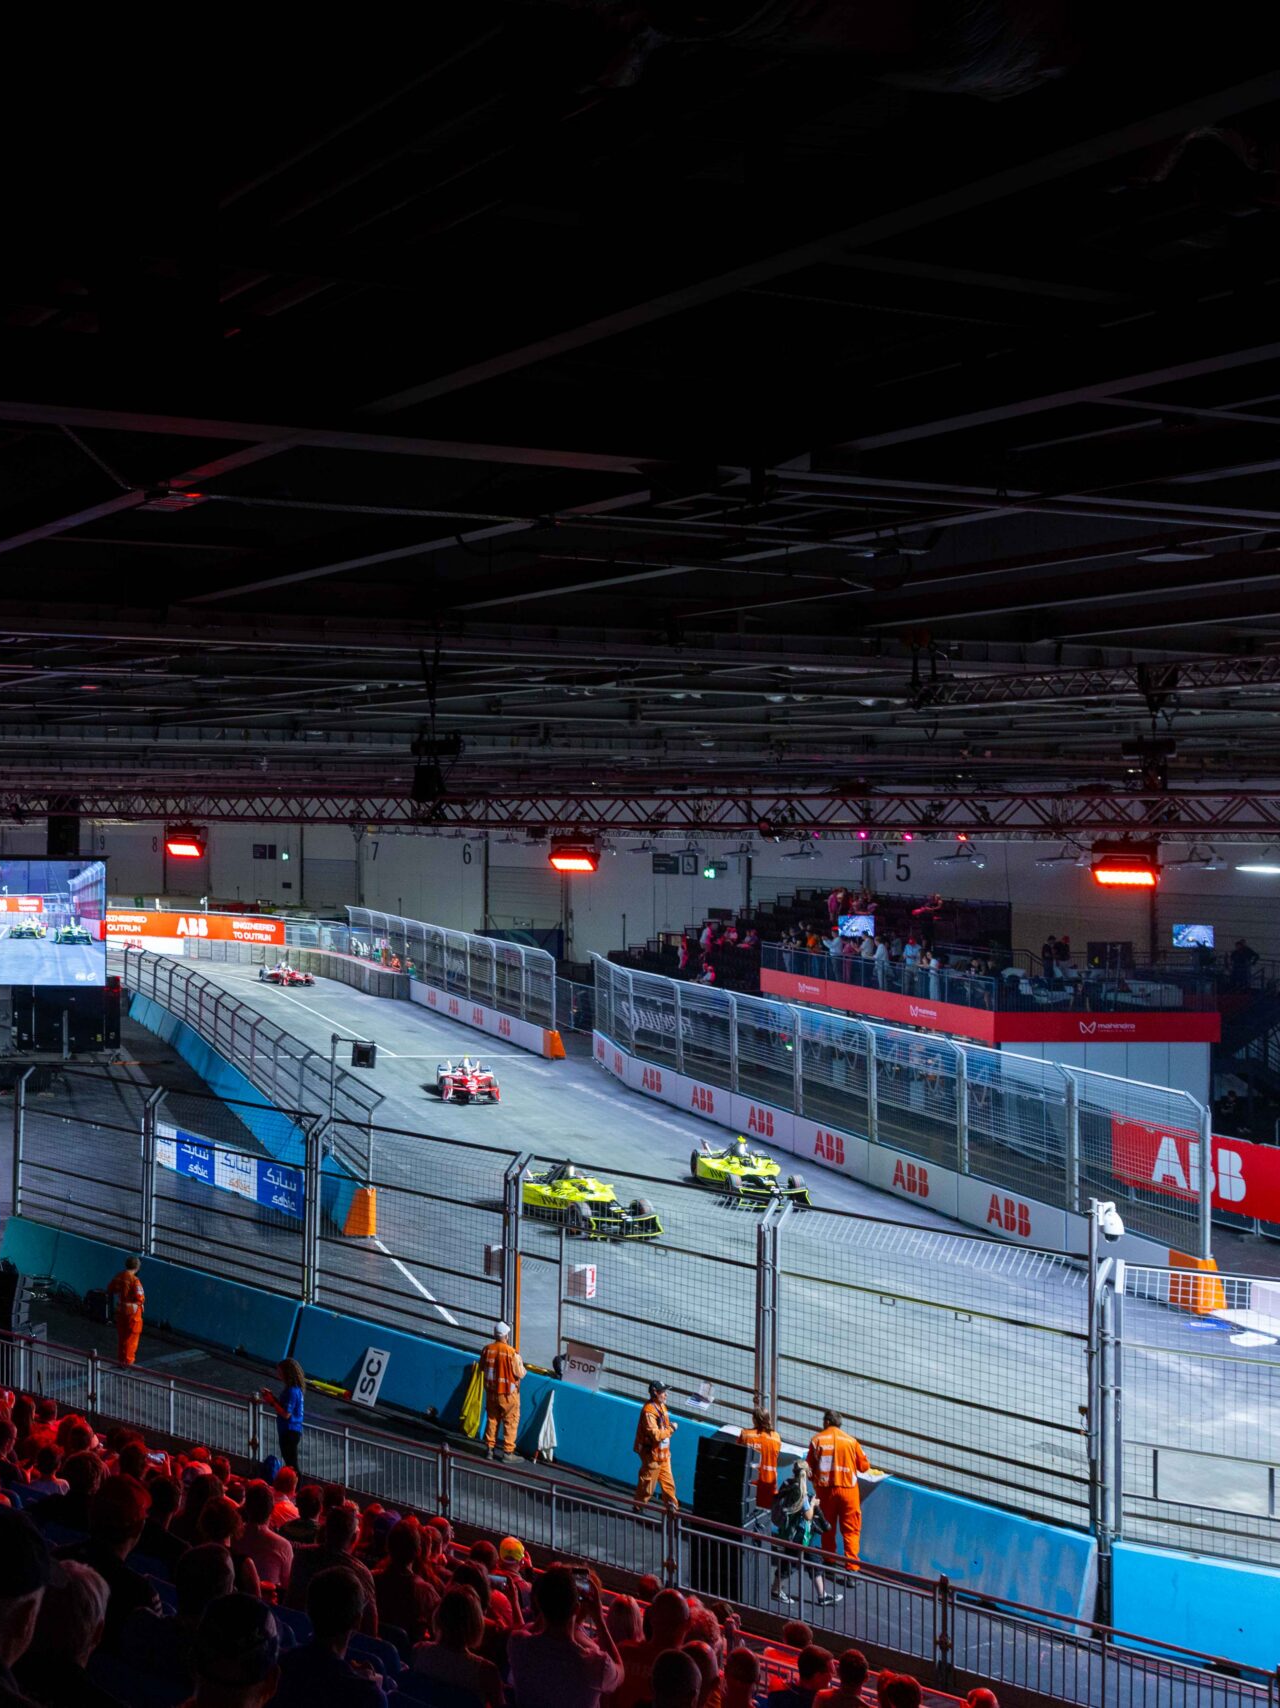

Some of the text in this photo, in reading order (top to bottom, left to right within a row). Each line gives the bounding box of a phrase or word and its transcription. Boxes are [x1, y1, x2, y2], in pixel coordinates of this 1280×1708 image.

[152, 836, 158, 853] 8
[371, 841, 379, 861] 7
[462, 843, 472, 865] 6
[895, 853, 911, 882] 5
[176, 917, 208, 936] ABB
[232, 921, 276, 932] ENGINEERED
[233, 931, 271, 941] TO OUTRUN
[449, 999, 459, 1015] ABB
[473, 1008, 483, 1026] ABB
[499, 1018, 511, 1036] ABB
[642, 1067, 662, 1093] ABB
[691, 1086, 714, 1114] ABB
[748, 1105, 774, 1138] ABB
[814, 1130, 845, 1165] ABB
[892, 1159, 929, 1198] ABB
[1151, 1135, 1247, 1203] ABB
[986, 1194, 1031, 1238] ABB
[360, 1358, 382, 1396] SC
[569, 1359, 596, 1375] STOP
